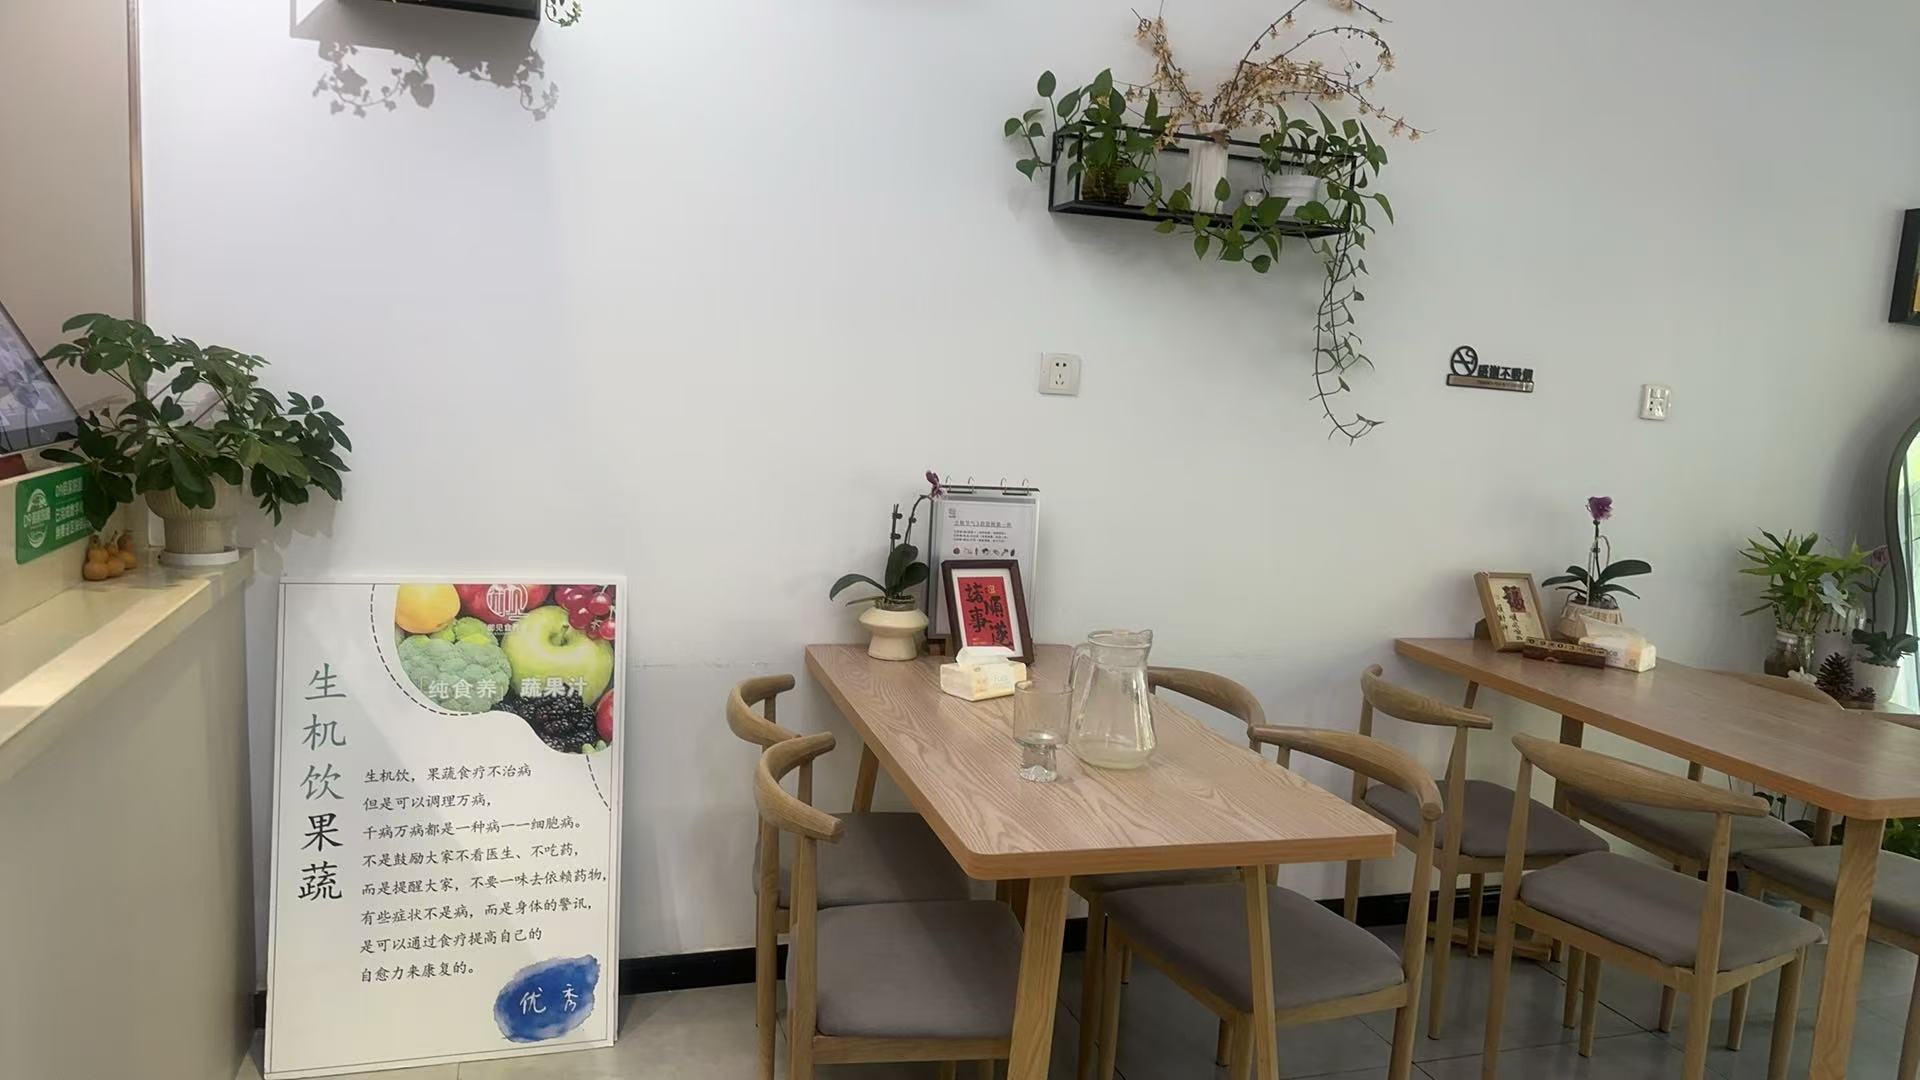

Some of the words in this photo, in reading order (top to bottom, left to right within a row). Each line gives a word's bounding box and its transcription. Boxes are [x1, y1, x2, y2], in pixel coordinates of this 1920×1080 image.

[519, 676, 588, 698] 蔬果汁
[298, 662, 347, 901] 生机饮果蔬
[360, 927, 542, 954] 是可以通过食疗提高自己的
[360, 960, 477, 983] 自愈力来康复的。
[519, 984, 580, 1016] 优秀
